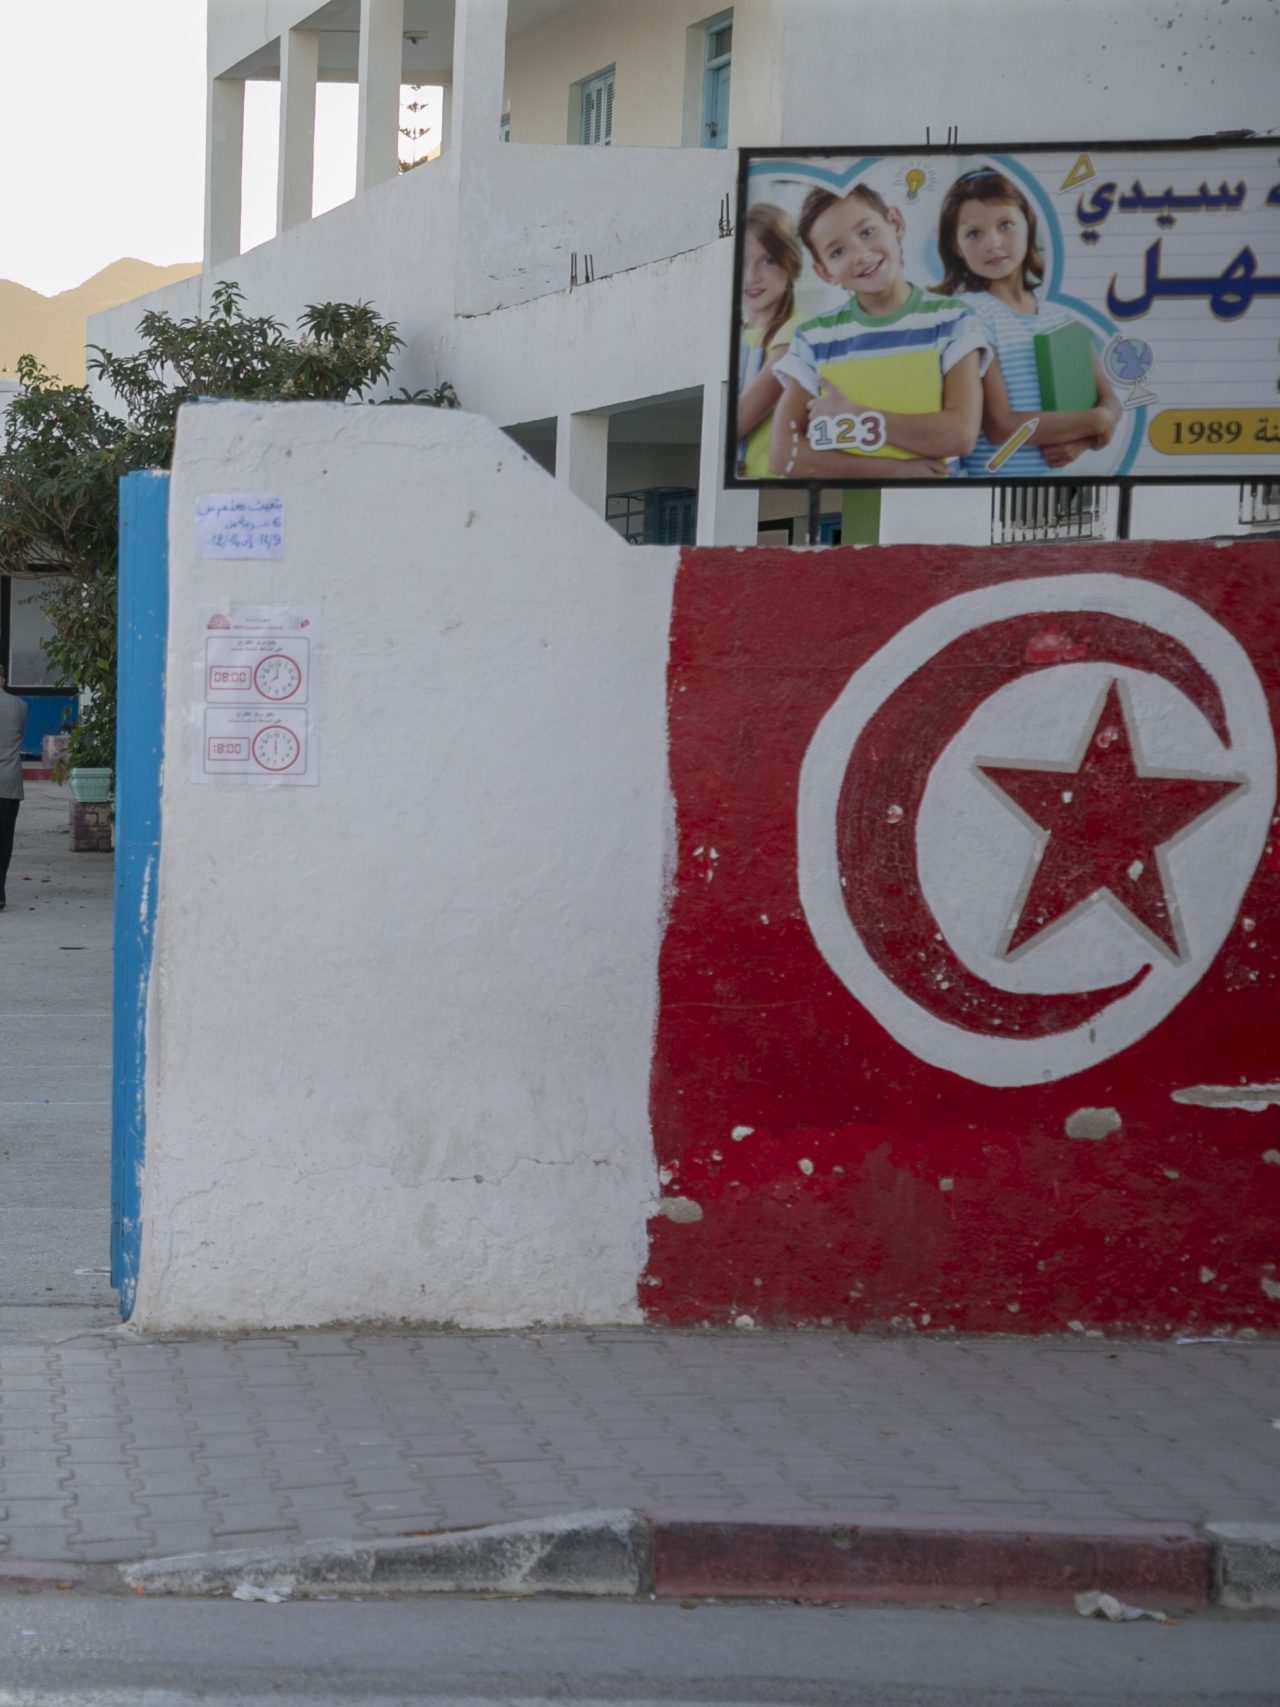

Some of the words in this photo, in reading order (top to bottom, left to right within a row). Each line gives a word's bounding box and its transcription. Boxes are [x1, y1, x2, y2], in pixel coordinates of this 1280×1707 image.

[1076, 179, 1247, 245] سيدي
[813, 416, 882, 446] 123
[1172, 420, 1243, 444] 1989
